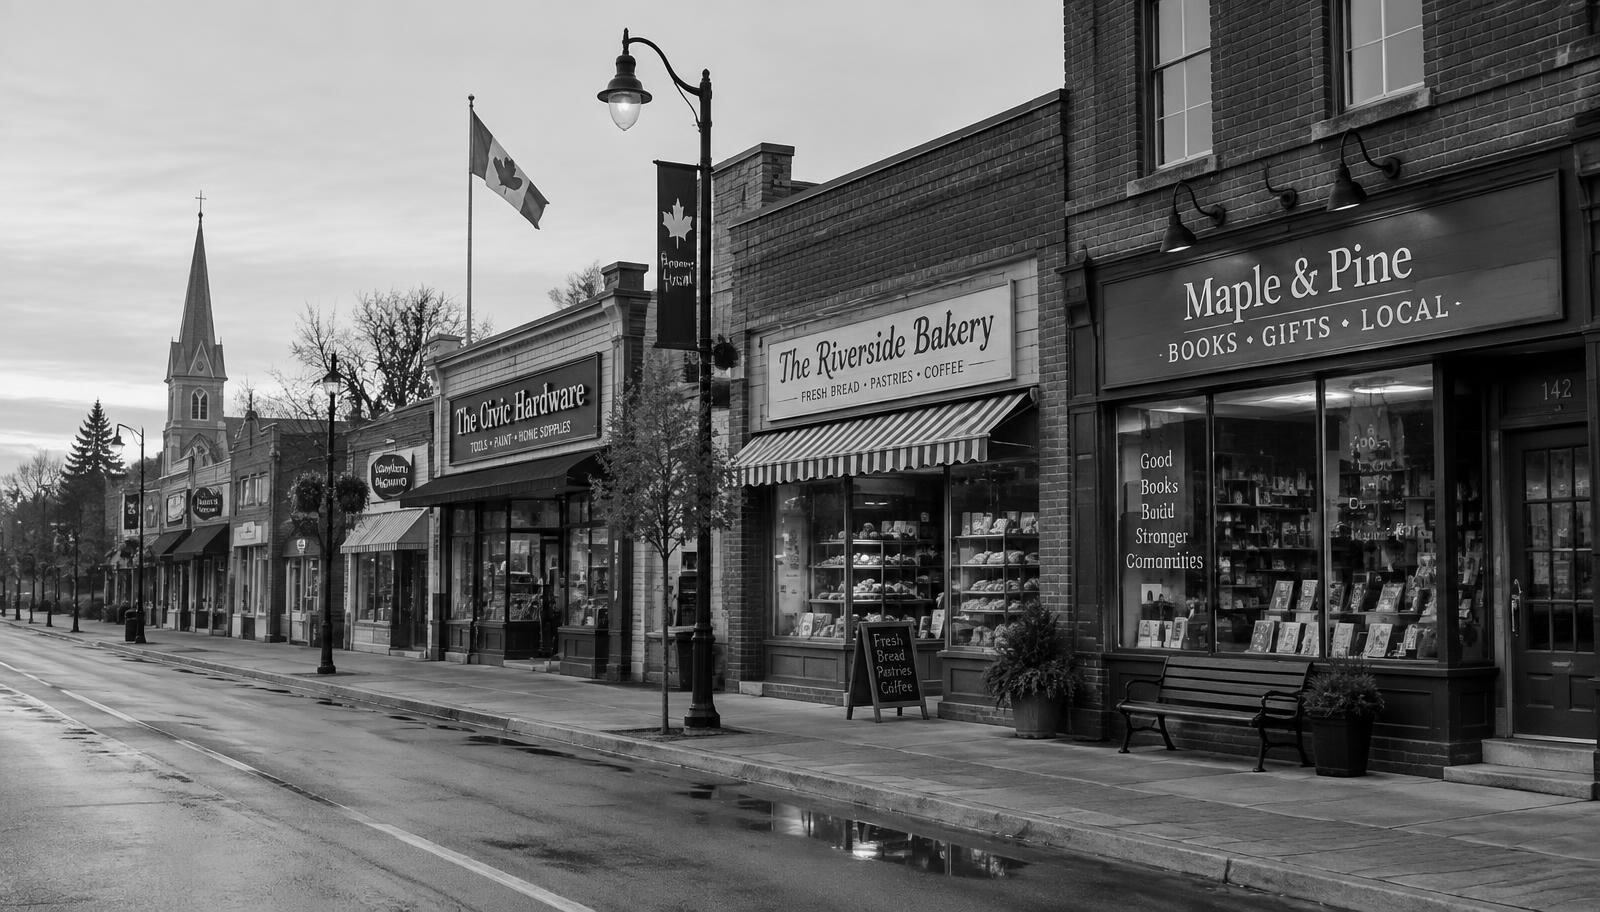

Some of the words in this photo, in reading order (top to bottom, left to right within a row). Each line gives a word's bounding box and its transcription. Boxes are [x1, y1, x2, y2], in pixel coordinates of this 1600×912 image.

[1184, 263, 1281, 323] Maple
[1291, 257, 1318, 298] &
[1328, 243, 1413, 293] Pine
[1168, 332, 1238, 363] BOOKS
[1262, 316, 1331, 347] GIFTS
[1361, 295, 1449, 331] LOCAL
[779, 347, 811, 384] The
[816, 324, 906, 380] Riverside
[913, 309, 994, 355] Bakery
[801, 384, 828, 403] FRESH
[830, 381, 860, 397] BREAD
[870, 370, 913, 389] PASTRIES
[924, 360, 964, 379] COFFEE
[1541, 378, 1572, 401] 142
[455, 406, 477, 435] The
[480, 397, 511, 429] Civic
[514, 382, 585, 422] Hardware
[1141, 449, 1173, 469] Good
[1141, 475, 1179, 495] Books
[1135, 527, 1189, 549] Stronger
[873, 633, 904, 648] Fresh
[876, 648, 906, 663] Bread
